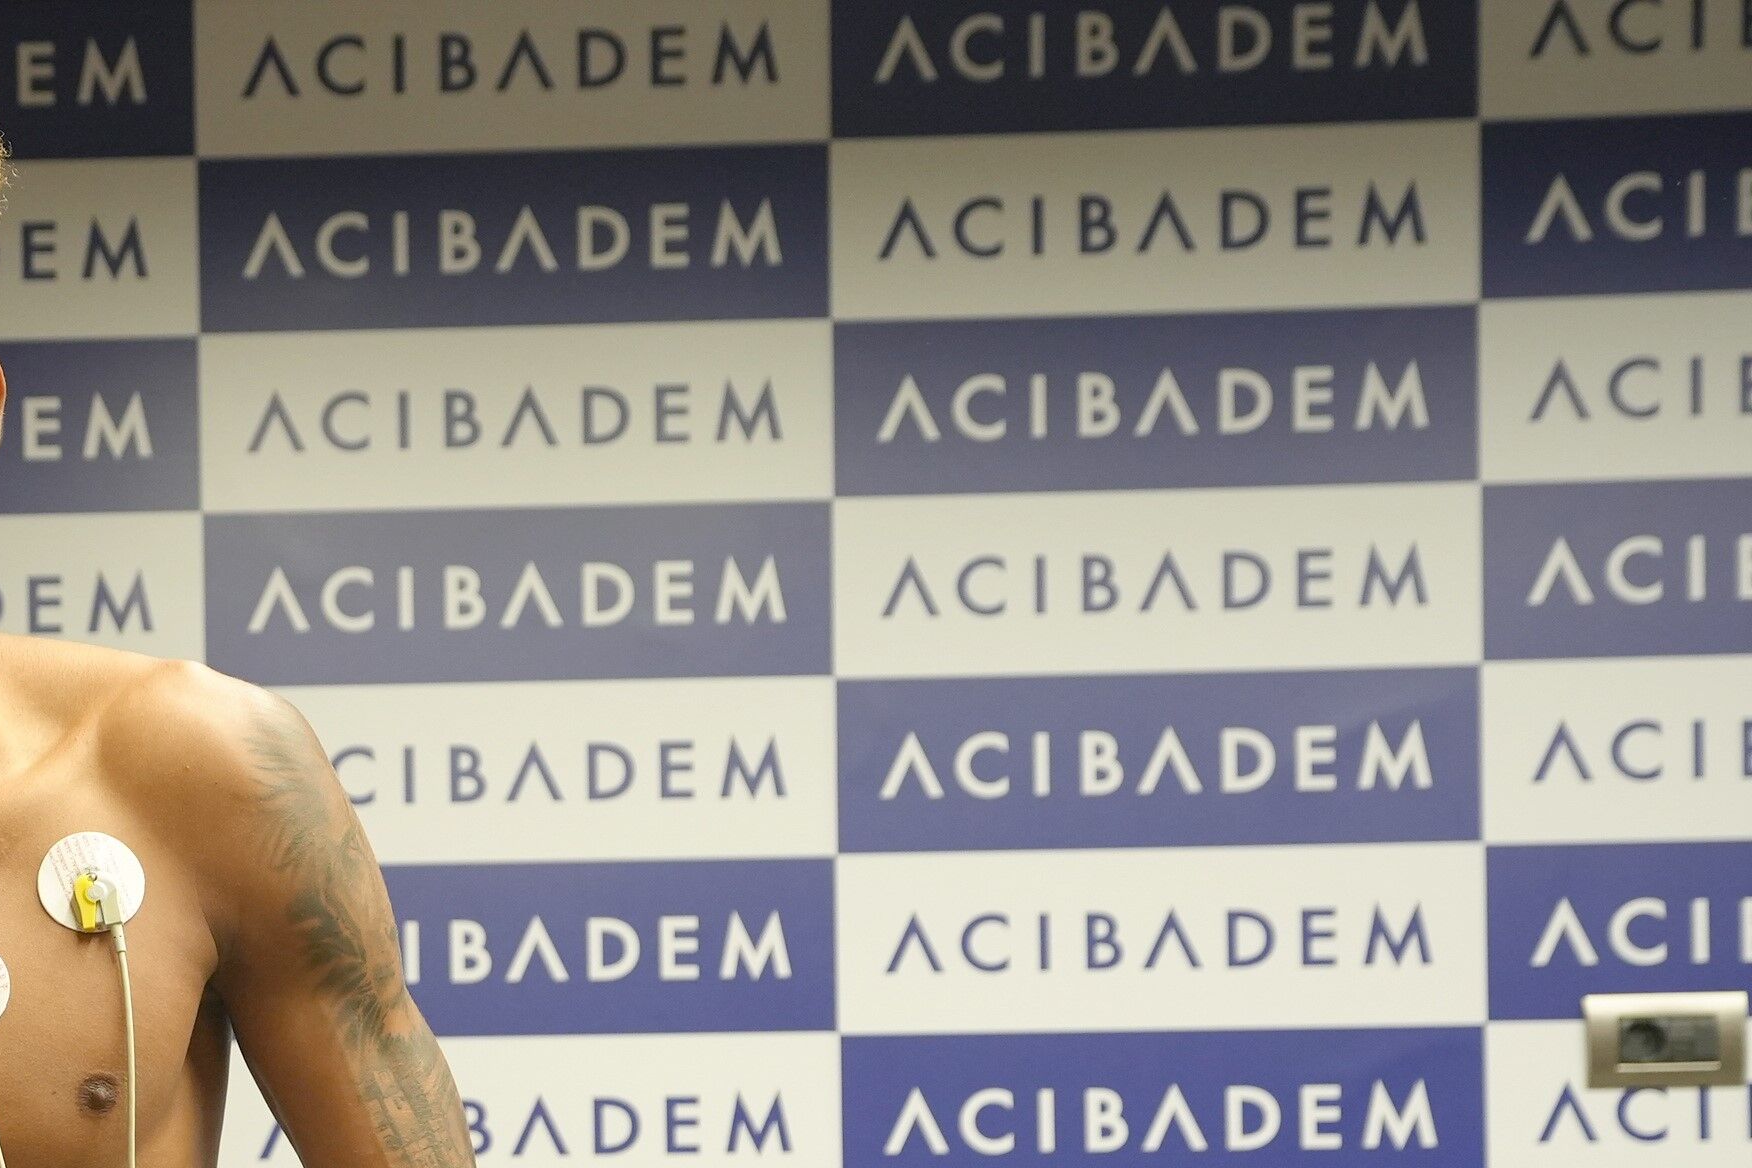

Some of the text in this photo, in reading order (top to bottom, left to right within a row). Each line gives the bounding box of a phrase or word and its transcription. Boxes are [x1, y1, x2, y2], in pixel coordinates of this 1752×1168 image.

[241, 22, 780, 100] ACIBADEM
[875, 0, 1429, 84] ACIBADEM
[242, 200, 783, 280] ACIBADEM
[877, 182, 1427, 261] ACIBADEM
[247, 380, 783, 454] ACIBADEM
[877, 361, 1430, 443] ACIBADEM
[247, 556, 787, 634] ACIBADEM
[880, 545, 1429, 619] ACIBADEM
[332, 737, 788, 805] CIBADEM
[879, 721, 1433, 800] ACIBADEM
[403, 911, 793, 984] IBADEM
[885, 905, 1433, 975] ACIBADEM
[884, 1079, 1439, 1156] ACIBADEM
